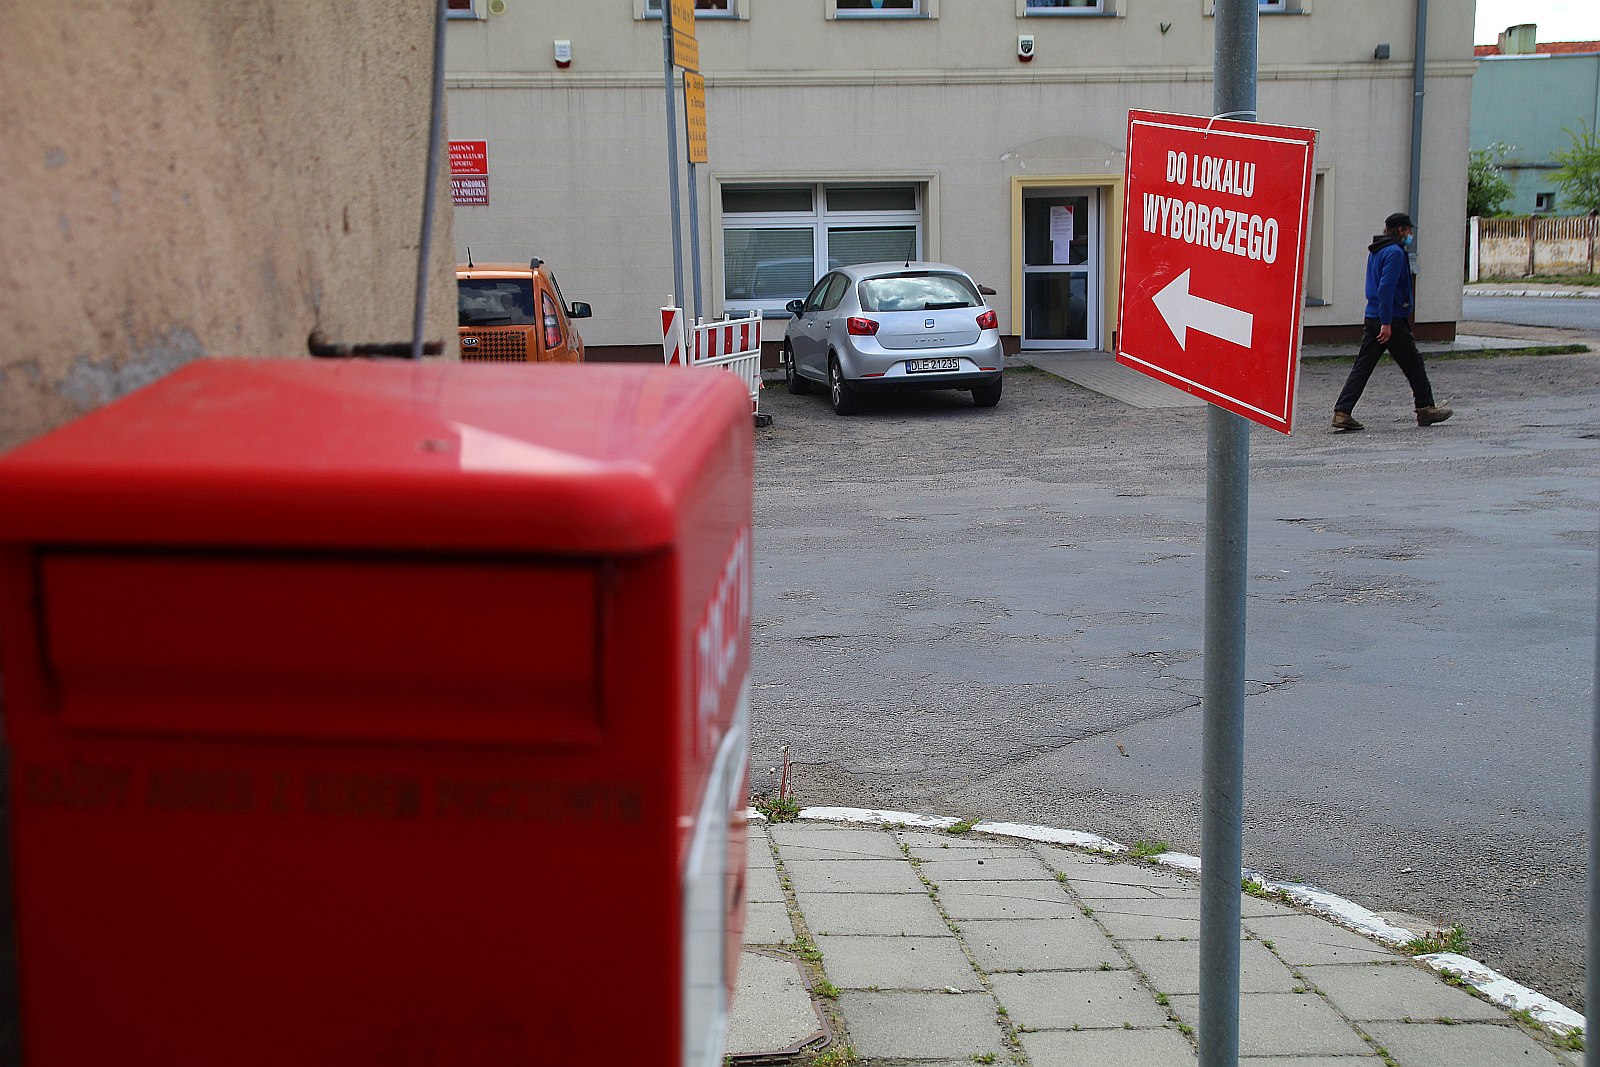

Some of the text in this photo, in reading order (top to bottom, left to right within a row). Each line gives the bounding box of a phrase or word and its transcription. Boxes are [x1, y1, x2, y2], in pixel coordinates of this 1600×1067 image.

[1166, 150, 1256, 198] DO LOKALU
[1143, 192, 1279, 265] WYBORCZEGO
[911, 358, 958, 371] DLE 21235
